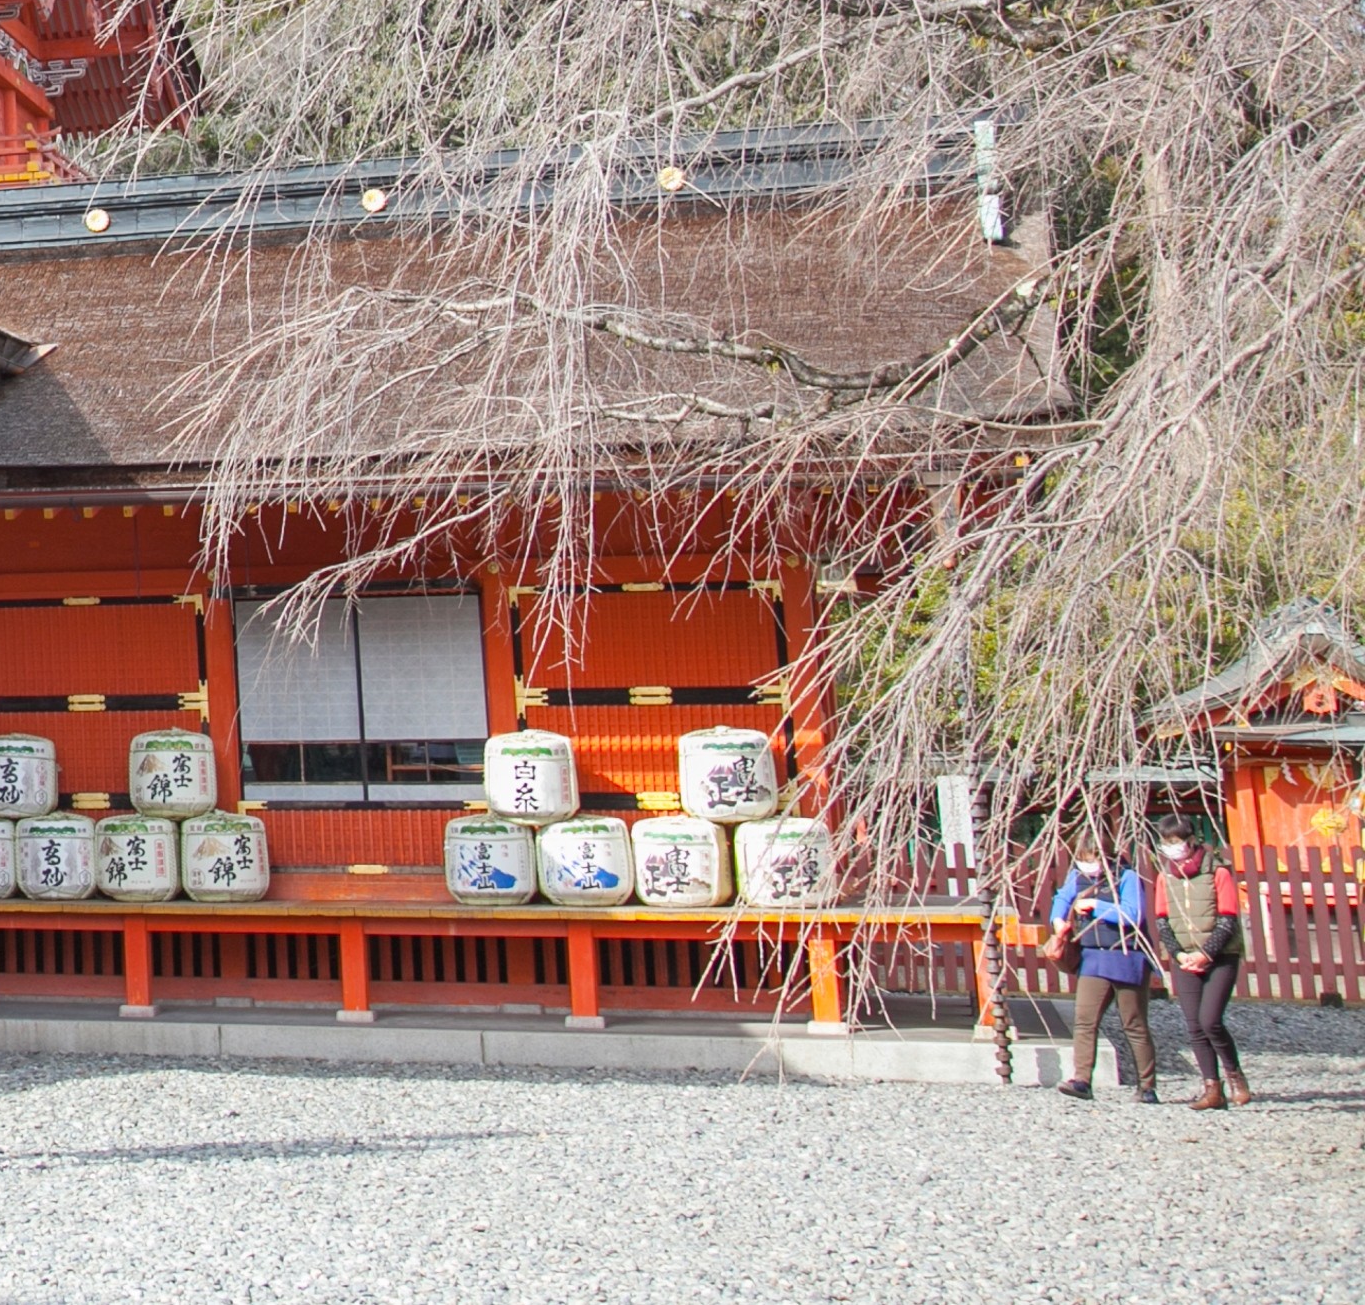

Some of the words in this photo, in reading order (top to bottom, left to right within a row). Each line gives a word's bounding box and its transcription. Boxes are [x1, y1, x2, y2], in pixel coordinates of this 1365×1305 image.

[514, 760, 540, 813] 白糸
[474, 842, 495, 890] 富士山
[578, 841, 601, 890] 富士山
